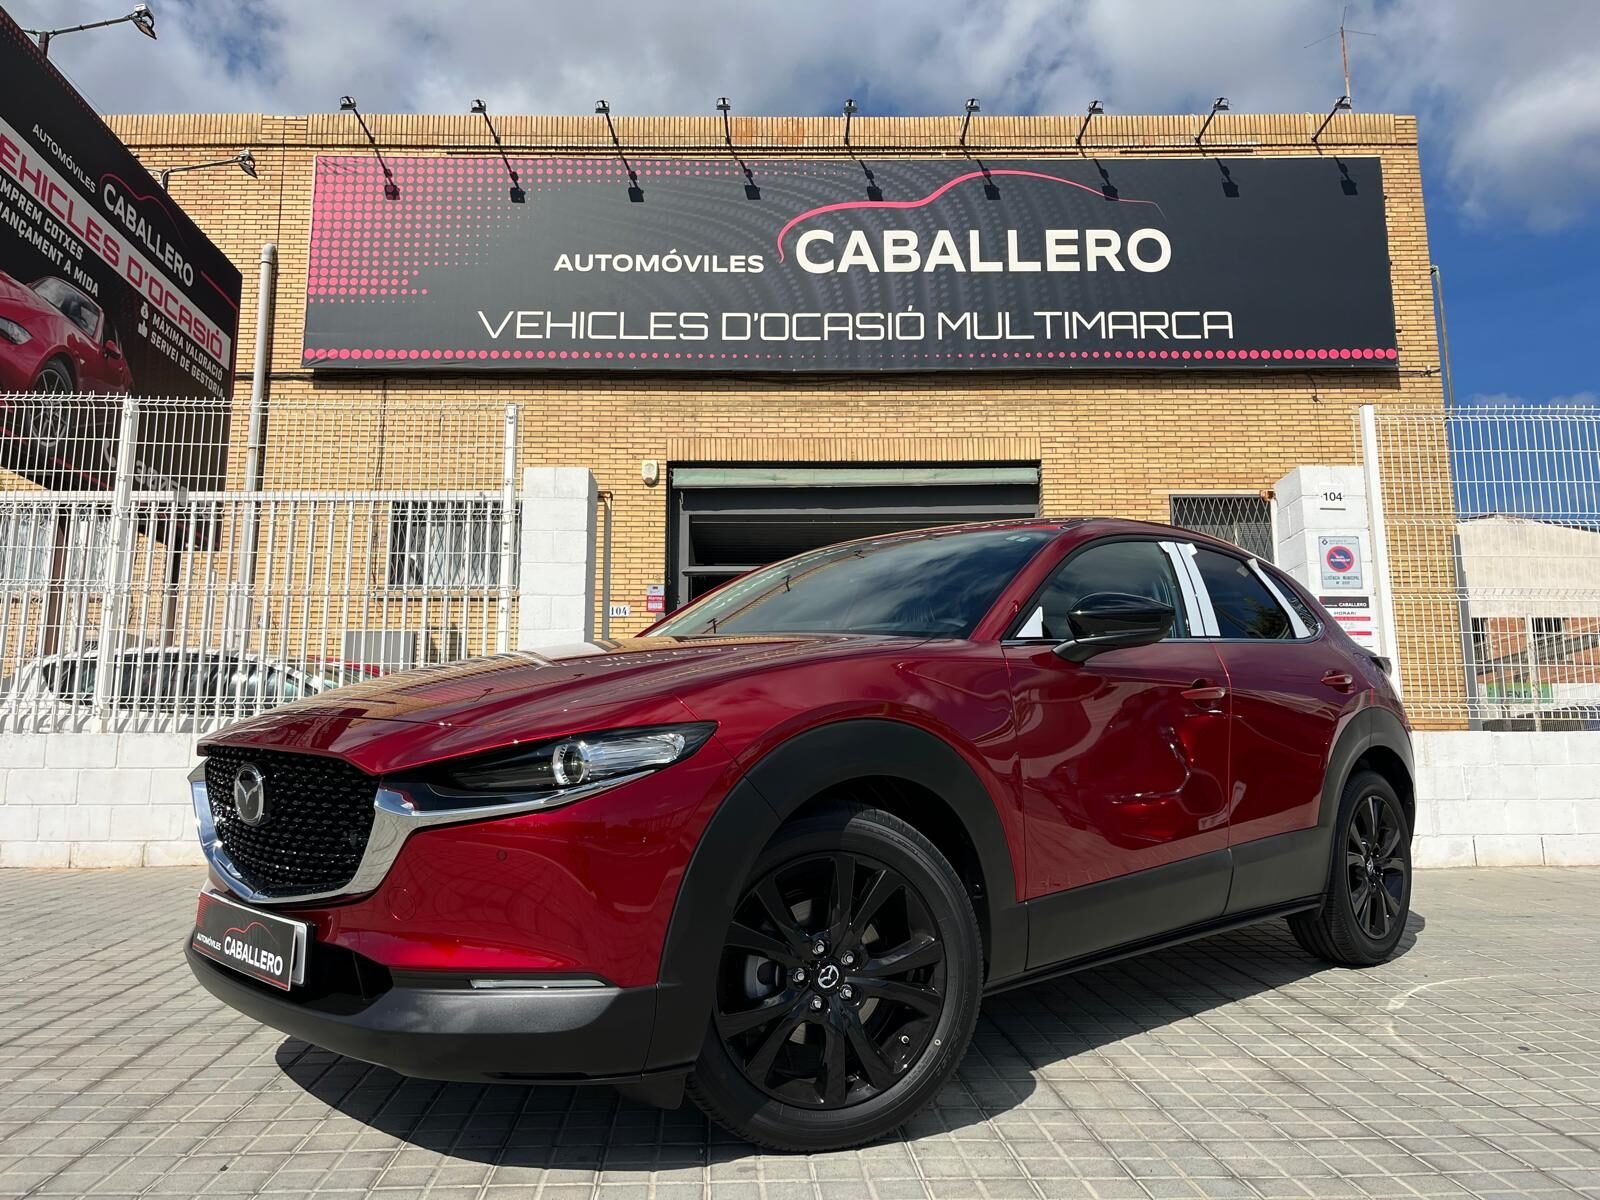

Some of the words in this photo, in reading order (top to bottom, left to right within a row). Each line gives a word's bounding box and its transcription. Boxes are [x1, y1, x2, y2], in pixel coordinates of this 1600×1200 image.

[0, 175, 42, 225] MPREM
[44, 217, 83, 260] COTXES
[32, 124, 96, 194] AUTOMÓVILES
[104, 183, 194, 287] CABALLERO
[0, 133, 120, 267] EHICLES
[127, 255, 222, 360] D'OCASIÓ
[553, 249, 764, 273] AUTOMÓVILES
[795, 228, 1172, 273] CABALLERO
[64, 259, 71, 275] A
[73, 266, 99, 297] MIDA
[477, 310, 709, 340] VEHICLES
[721, 305, 925, 341] D'OCASIÓ
[937, 311, 1234, 340] MULTIMARCA
[150, 331, 179, 363] SERVEI
[179, 355, 190, 372] DE
[1322, 492, 1343, 502] 104
[611, 606, 627, 615] 104
[224, 936, 283, 976] CABALLERO
